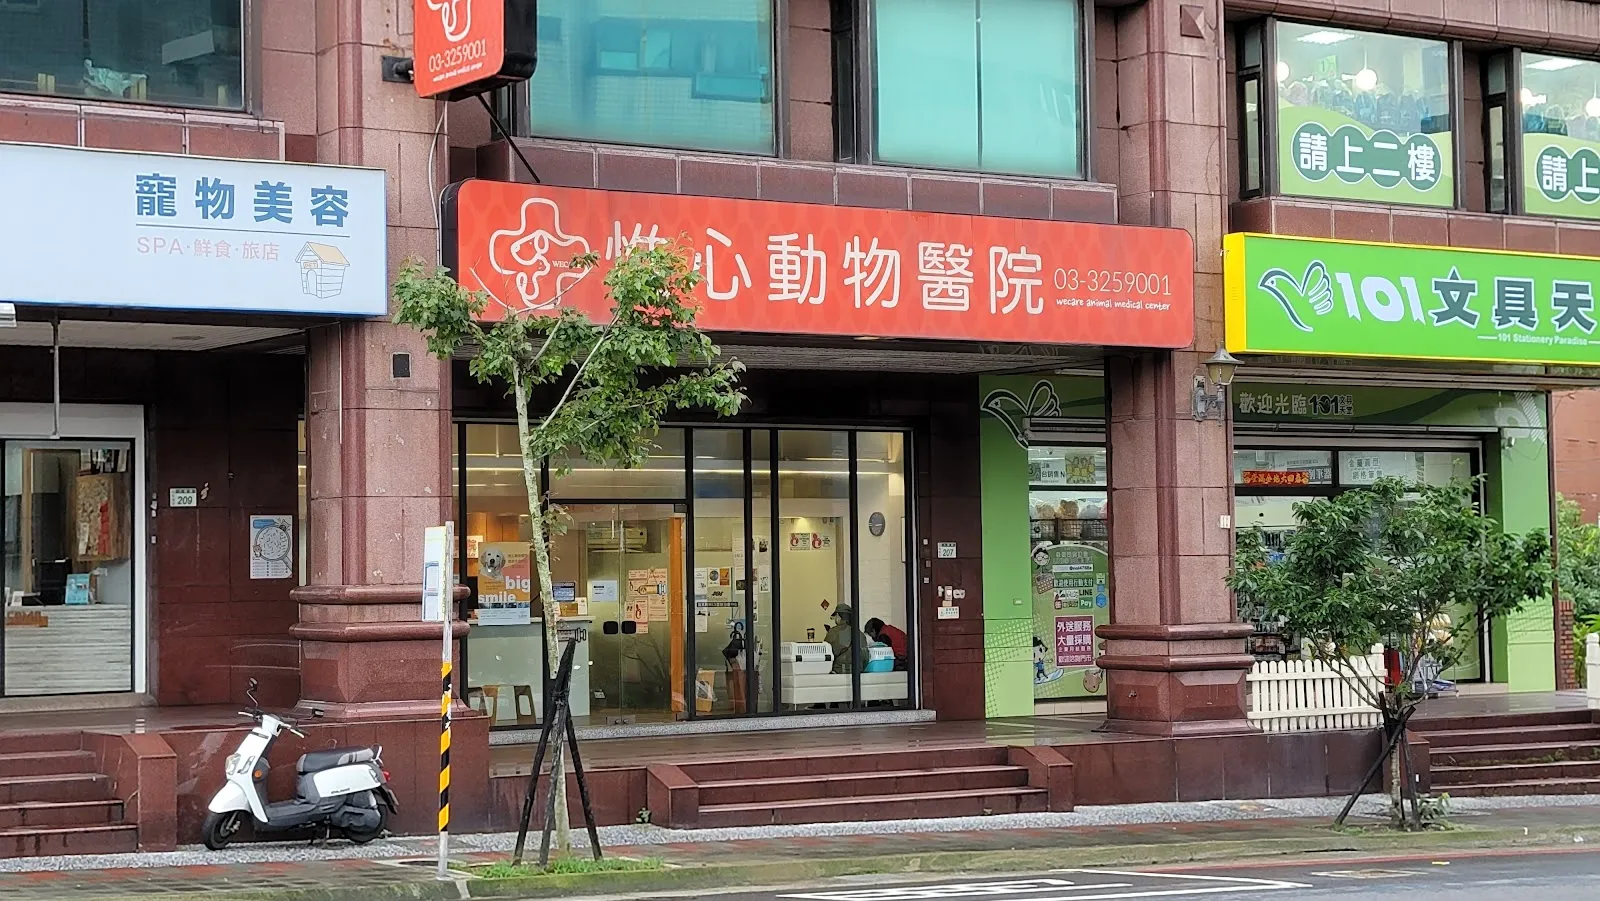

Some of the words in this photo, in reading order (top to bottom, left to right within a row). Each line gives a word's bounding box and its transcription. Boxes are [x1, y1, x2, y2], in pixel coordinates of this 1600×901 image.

[428, 38, 487, 72] 03-3259001
[1299, 131, 1436, 183] 請上二樓
[1541, 154, 1600, 194] 請上
[136, 173, 349, 228] 寵物美容
[1054, 267, 1172, 295] 03-3259001
[1056, 298, 1084, 307] wecare
[1086, 298, 1112, 308] animal
[1114, 299, 1143, 310] medical
[1145, 302, 1171, 311] center
[1498, 332, 1511, 342] 101
[1513, 333, 1553, 345] Stationery
[1554, 335, 1588, 346] Paradise
[177, 495, 193, 505] 209
[942, 548, 954, 557] 207
[505, 575, 530, 593] big
[478, 591, 516, 604] smile
[1080, 600, 1092, 608] Pay
[1057, 620, 1091, 632] 外送服務
[1057, 634, 1092, 646] 大量採購
